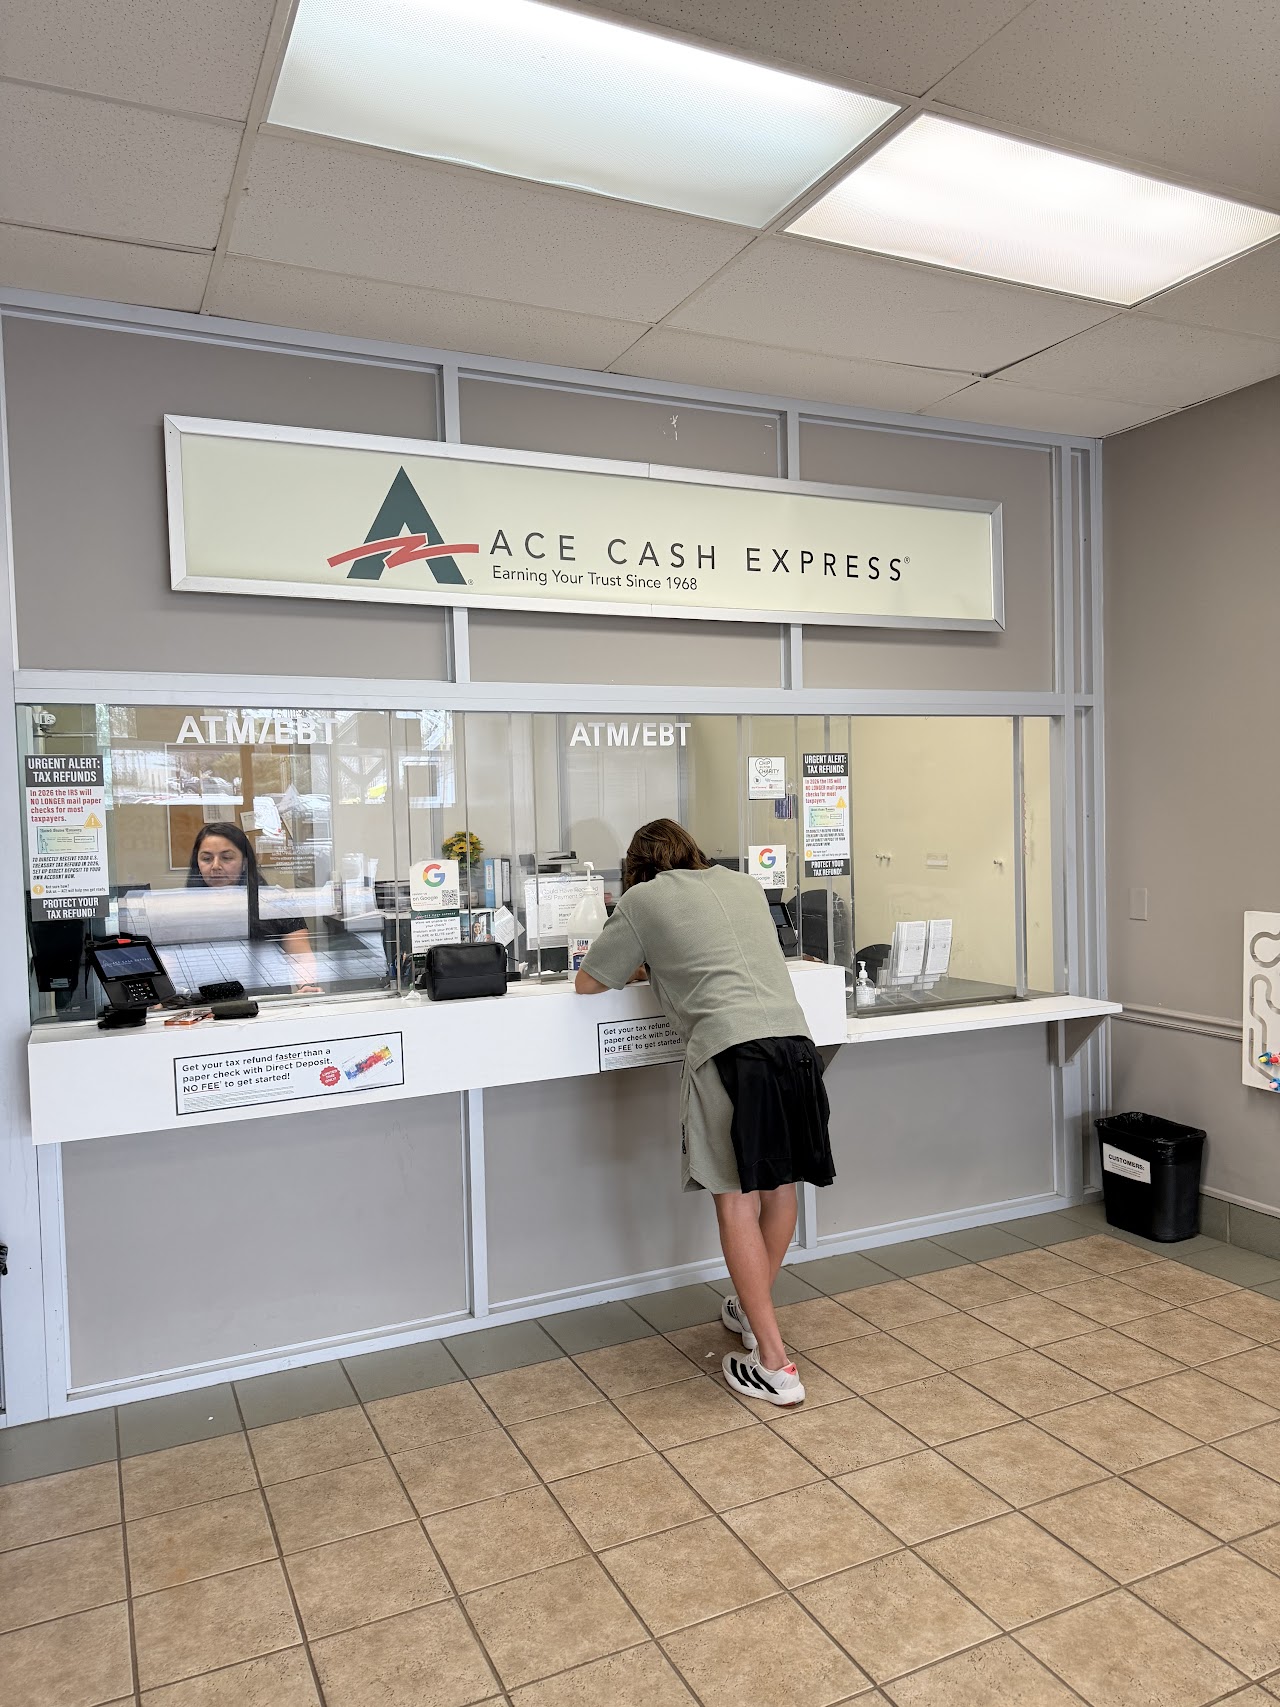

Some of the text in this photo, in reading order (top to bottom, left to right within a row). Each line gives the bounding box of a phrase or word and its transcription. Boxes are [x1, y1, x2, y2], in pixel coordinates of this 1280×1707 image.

[489, 529, 576, 561] ACE
[607, 538, 715, 570] CASH
[492, 565, 698, 590] Earning Your Trust Since 1968
[176, 715, 337, 744] ATM/EBT
[569, 722, 692, 746] ATM/EBT
[28, 757, 101, 769] URGENT ALERT:
[804, 755, 847, 763] URGENT ALERT:
[33, 771, 97, 782] TAX REFUNDS
[819, 765, 844, 773] REFUNDS
[42, 897, 99, 908] PROTECT YOUR
[46, 908, 96, 919] TAX REFUND!
[604, 1037, 625, 1045] paper
[626, 1033, 647, 1042] check
[182, 1064, 199, 1072] Get
[202, 1062, 222, 1070] your
[243, 1054, 272, 1064] refund
[183, 1058, 333, 1083] paper check with Direct Deposit.
[237, 1078, 252, 1087] get
[255, 1072, 290, 1083] started!
[1108, 1154, 1144, 1170] CUSTOMERS:
